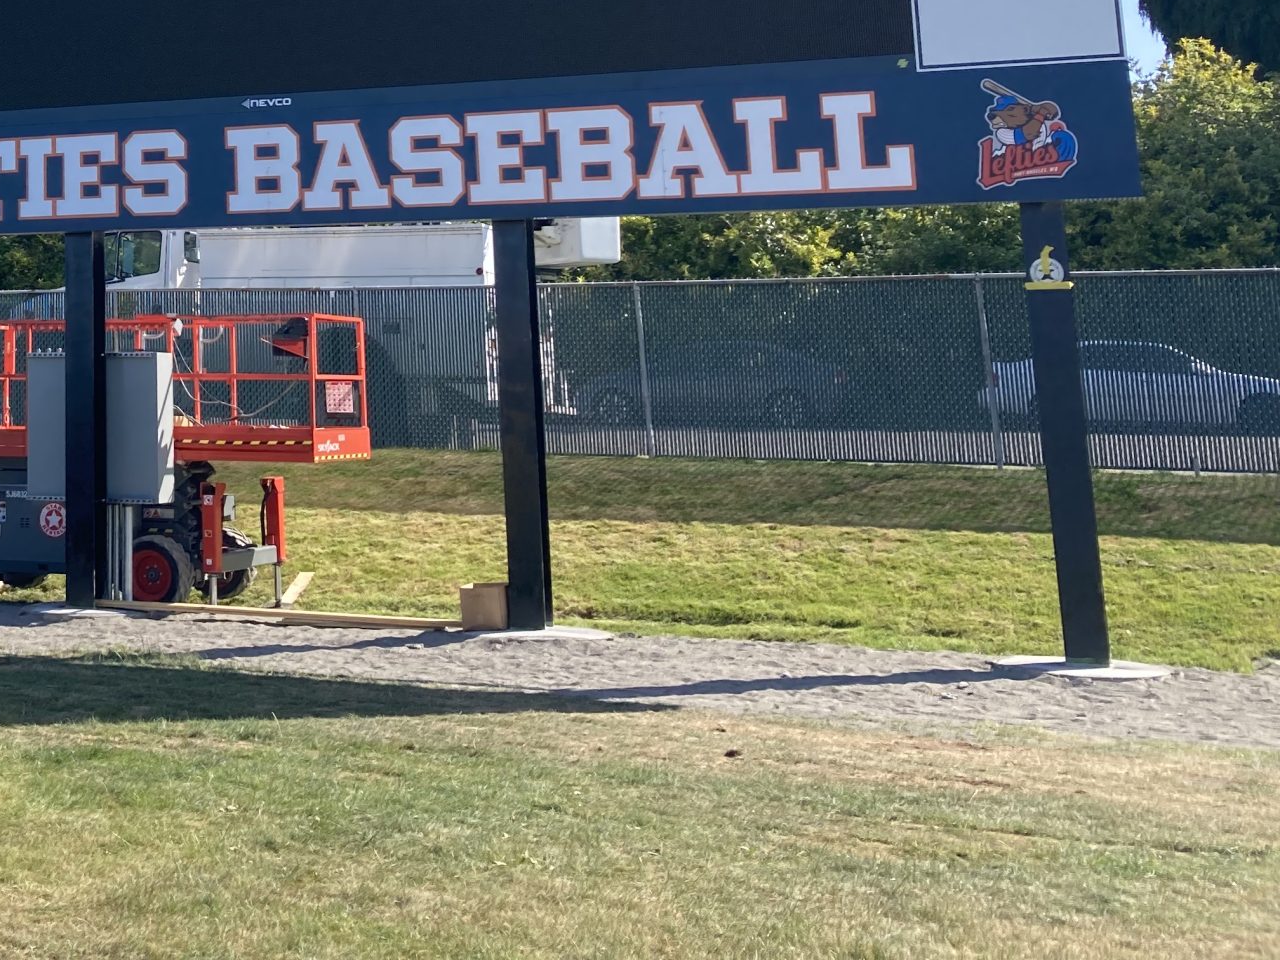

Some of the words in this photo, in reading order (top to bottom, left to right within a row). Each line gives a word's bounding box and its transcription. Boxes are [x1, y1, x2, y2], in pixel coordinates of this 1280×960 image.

[250, 97, 292, 108] NEVCO
[224, 91, 917, 214] BASEBALL
[981, 137, 1059, 187] Lefties
